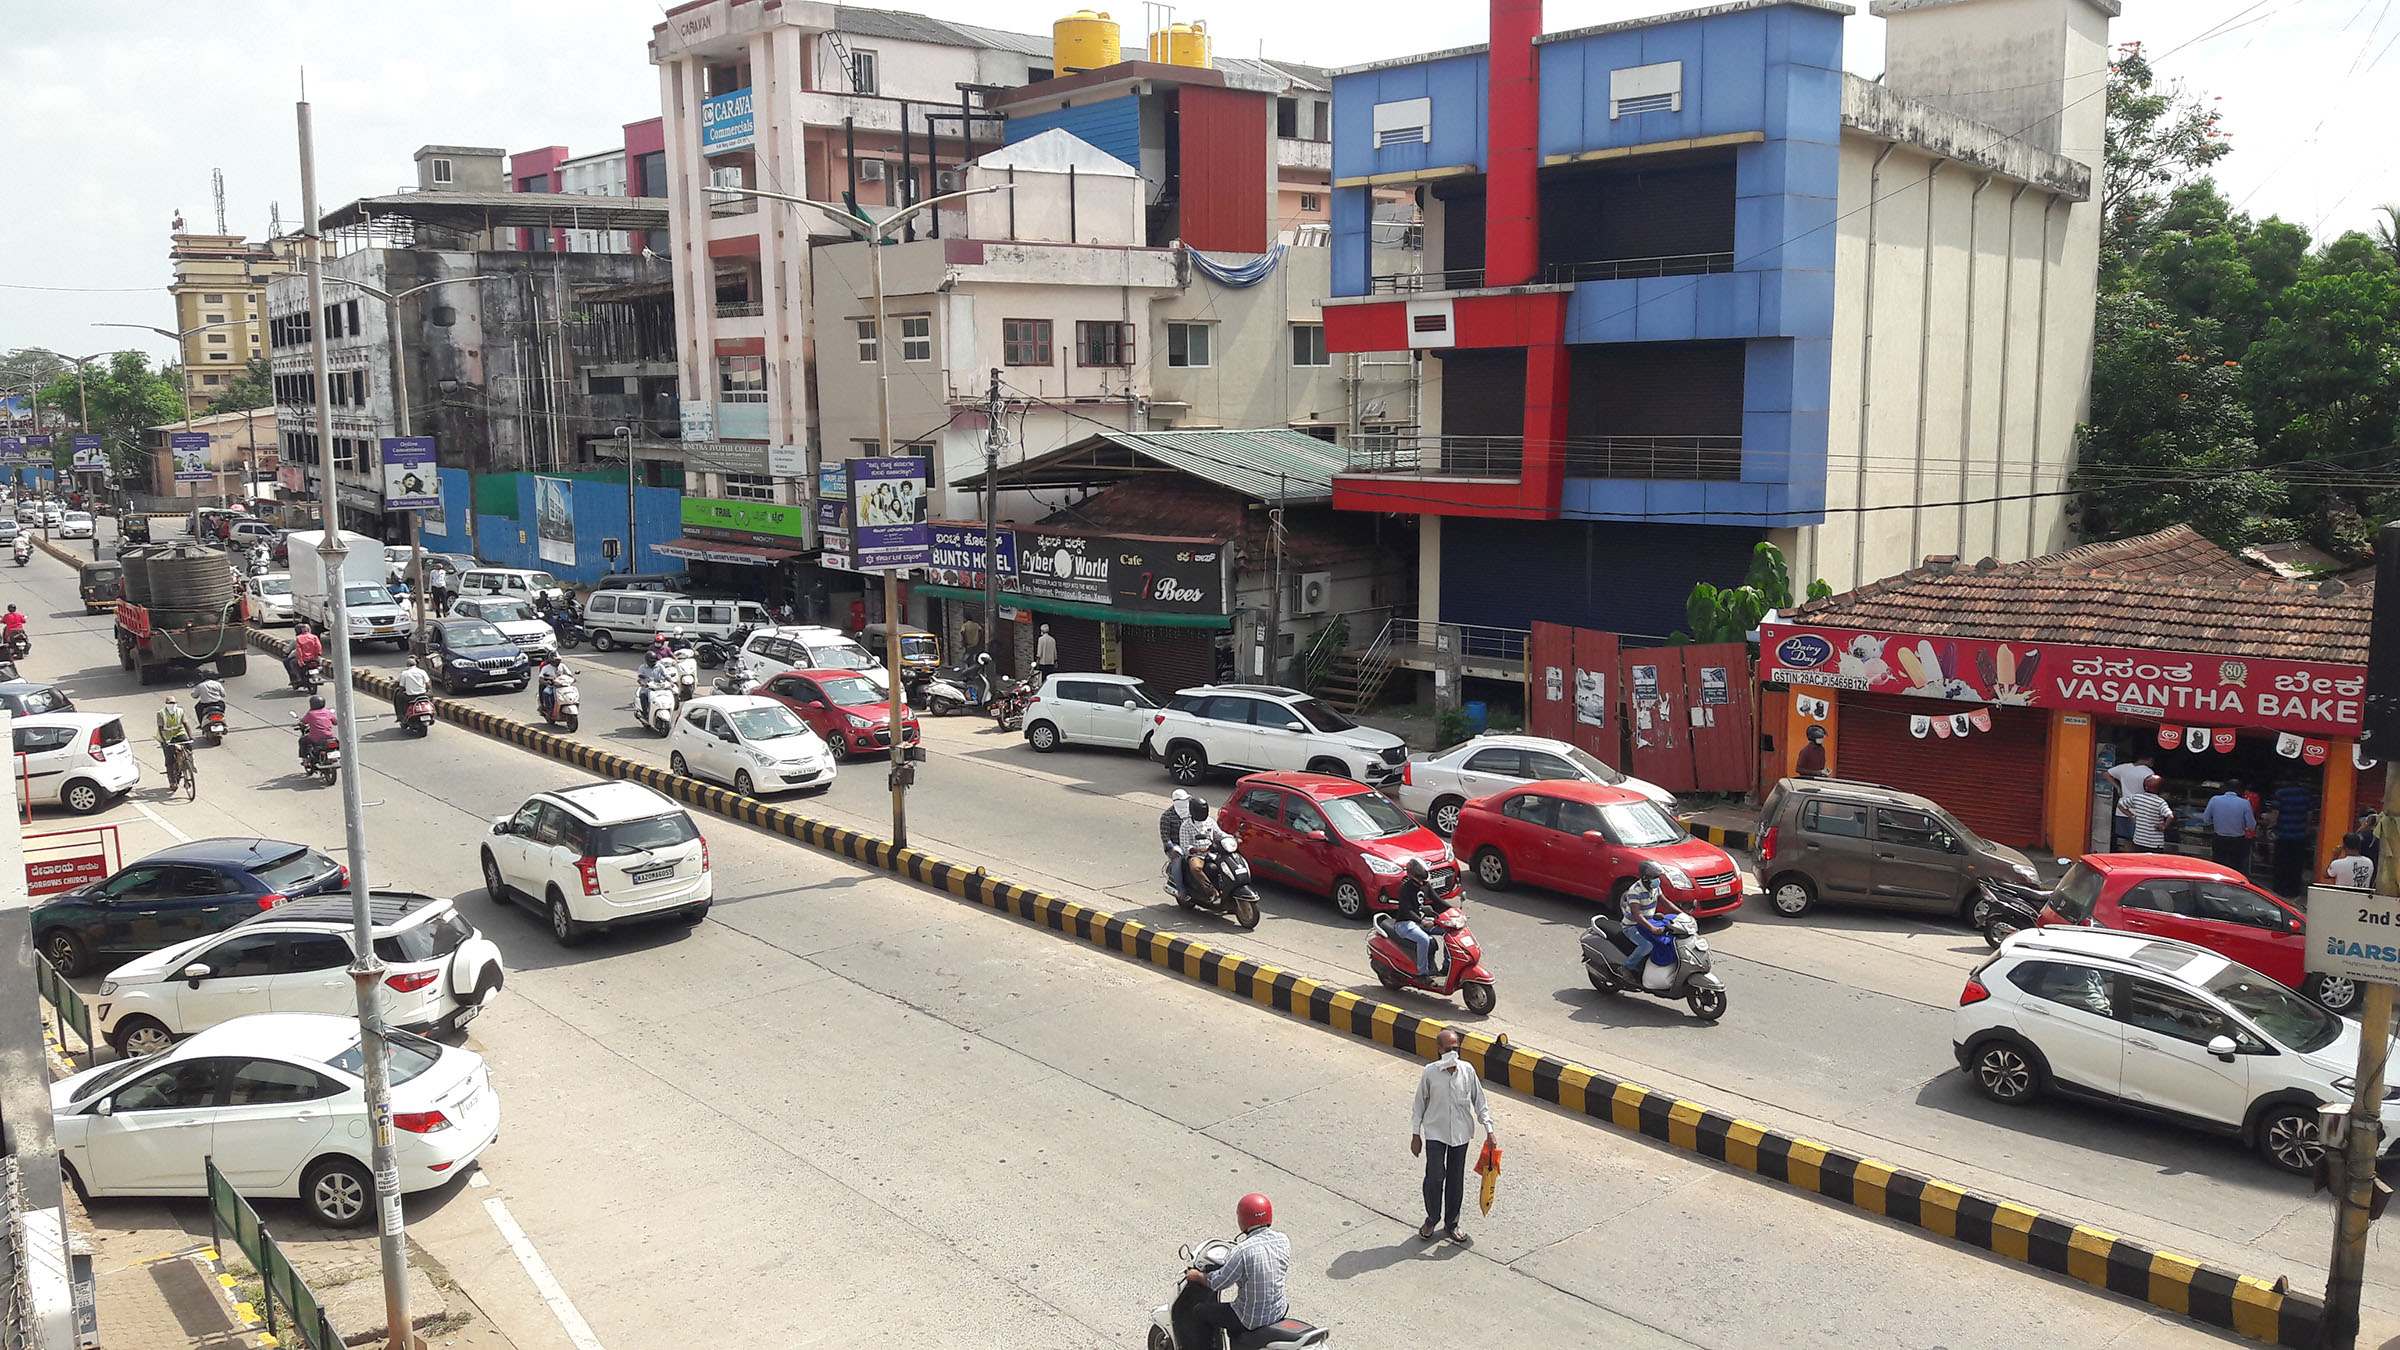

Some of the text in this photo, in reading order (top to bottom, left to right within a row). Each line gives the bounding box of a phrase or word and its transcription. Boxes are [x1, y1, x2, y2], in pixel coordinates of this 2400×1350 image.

[680, 15, 711, 37] CARAVAN
[714, 94, 752, 122] CARAVA
[710, 119, 753, 141] Commercials
[932, 547, 1011, 572] BUNTS HOEL
[1022, 550, 1109, 578] Cyber World
[1120, 554, 1143, 566] Cafe
[1141, 572, 1205, 602] 7 Bees
[1786, 638, 1822, 657] Dairy
[1790, 650, 1818, 667] Day
[2071, 656, 2193, 683] ವಸಂತ
[2225, 664, 2241, 678] 80
[2056, 676, 2359, 724] VASANTHA BAKE
[28, 878, 63, 889] SORROWS
[63, 875, 88, 885] CHURCH
[2358, 908, 2390, 926] 2nd
[2327, 936, 2400, 964] HARS
